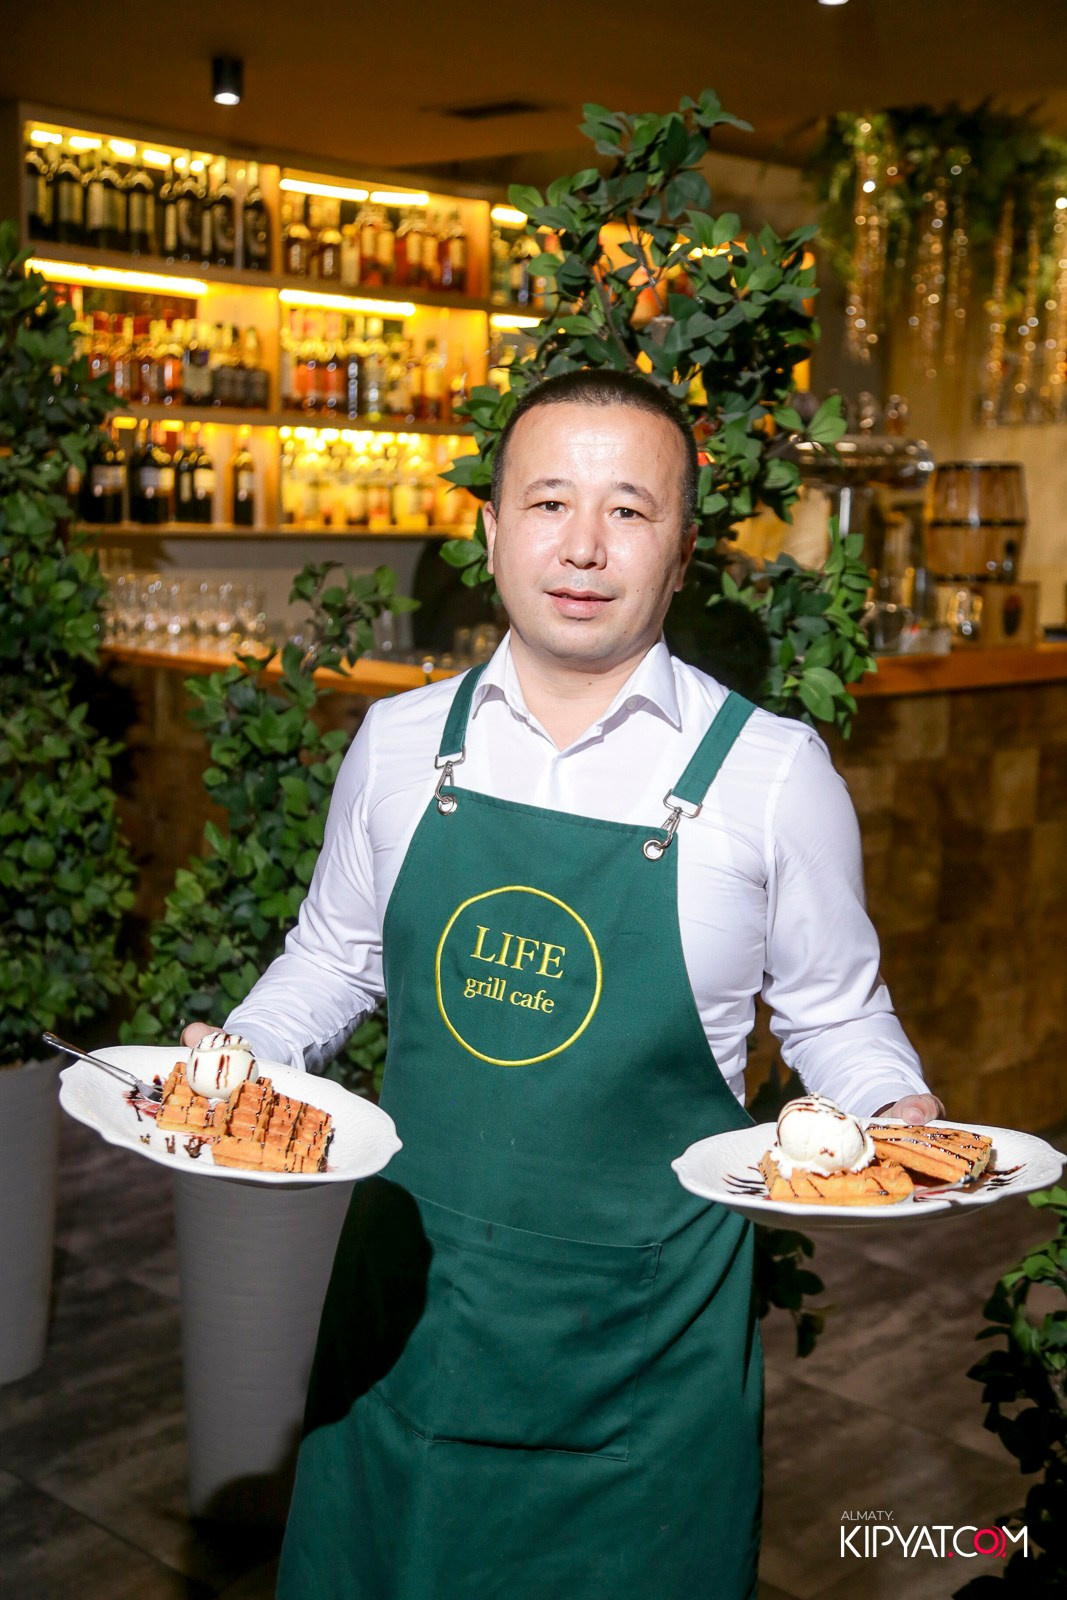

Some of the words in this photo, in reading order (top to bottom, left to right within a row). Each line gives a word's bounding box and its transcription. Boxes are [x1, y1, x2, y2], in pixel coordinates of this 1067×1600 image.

[470, 925, 566, 979] LIFE
[463, 976, 507, 1001] grill
[509, 989, 555, 1014] cafe
